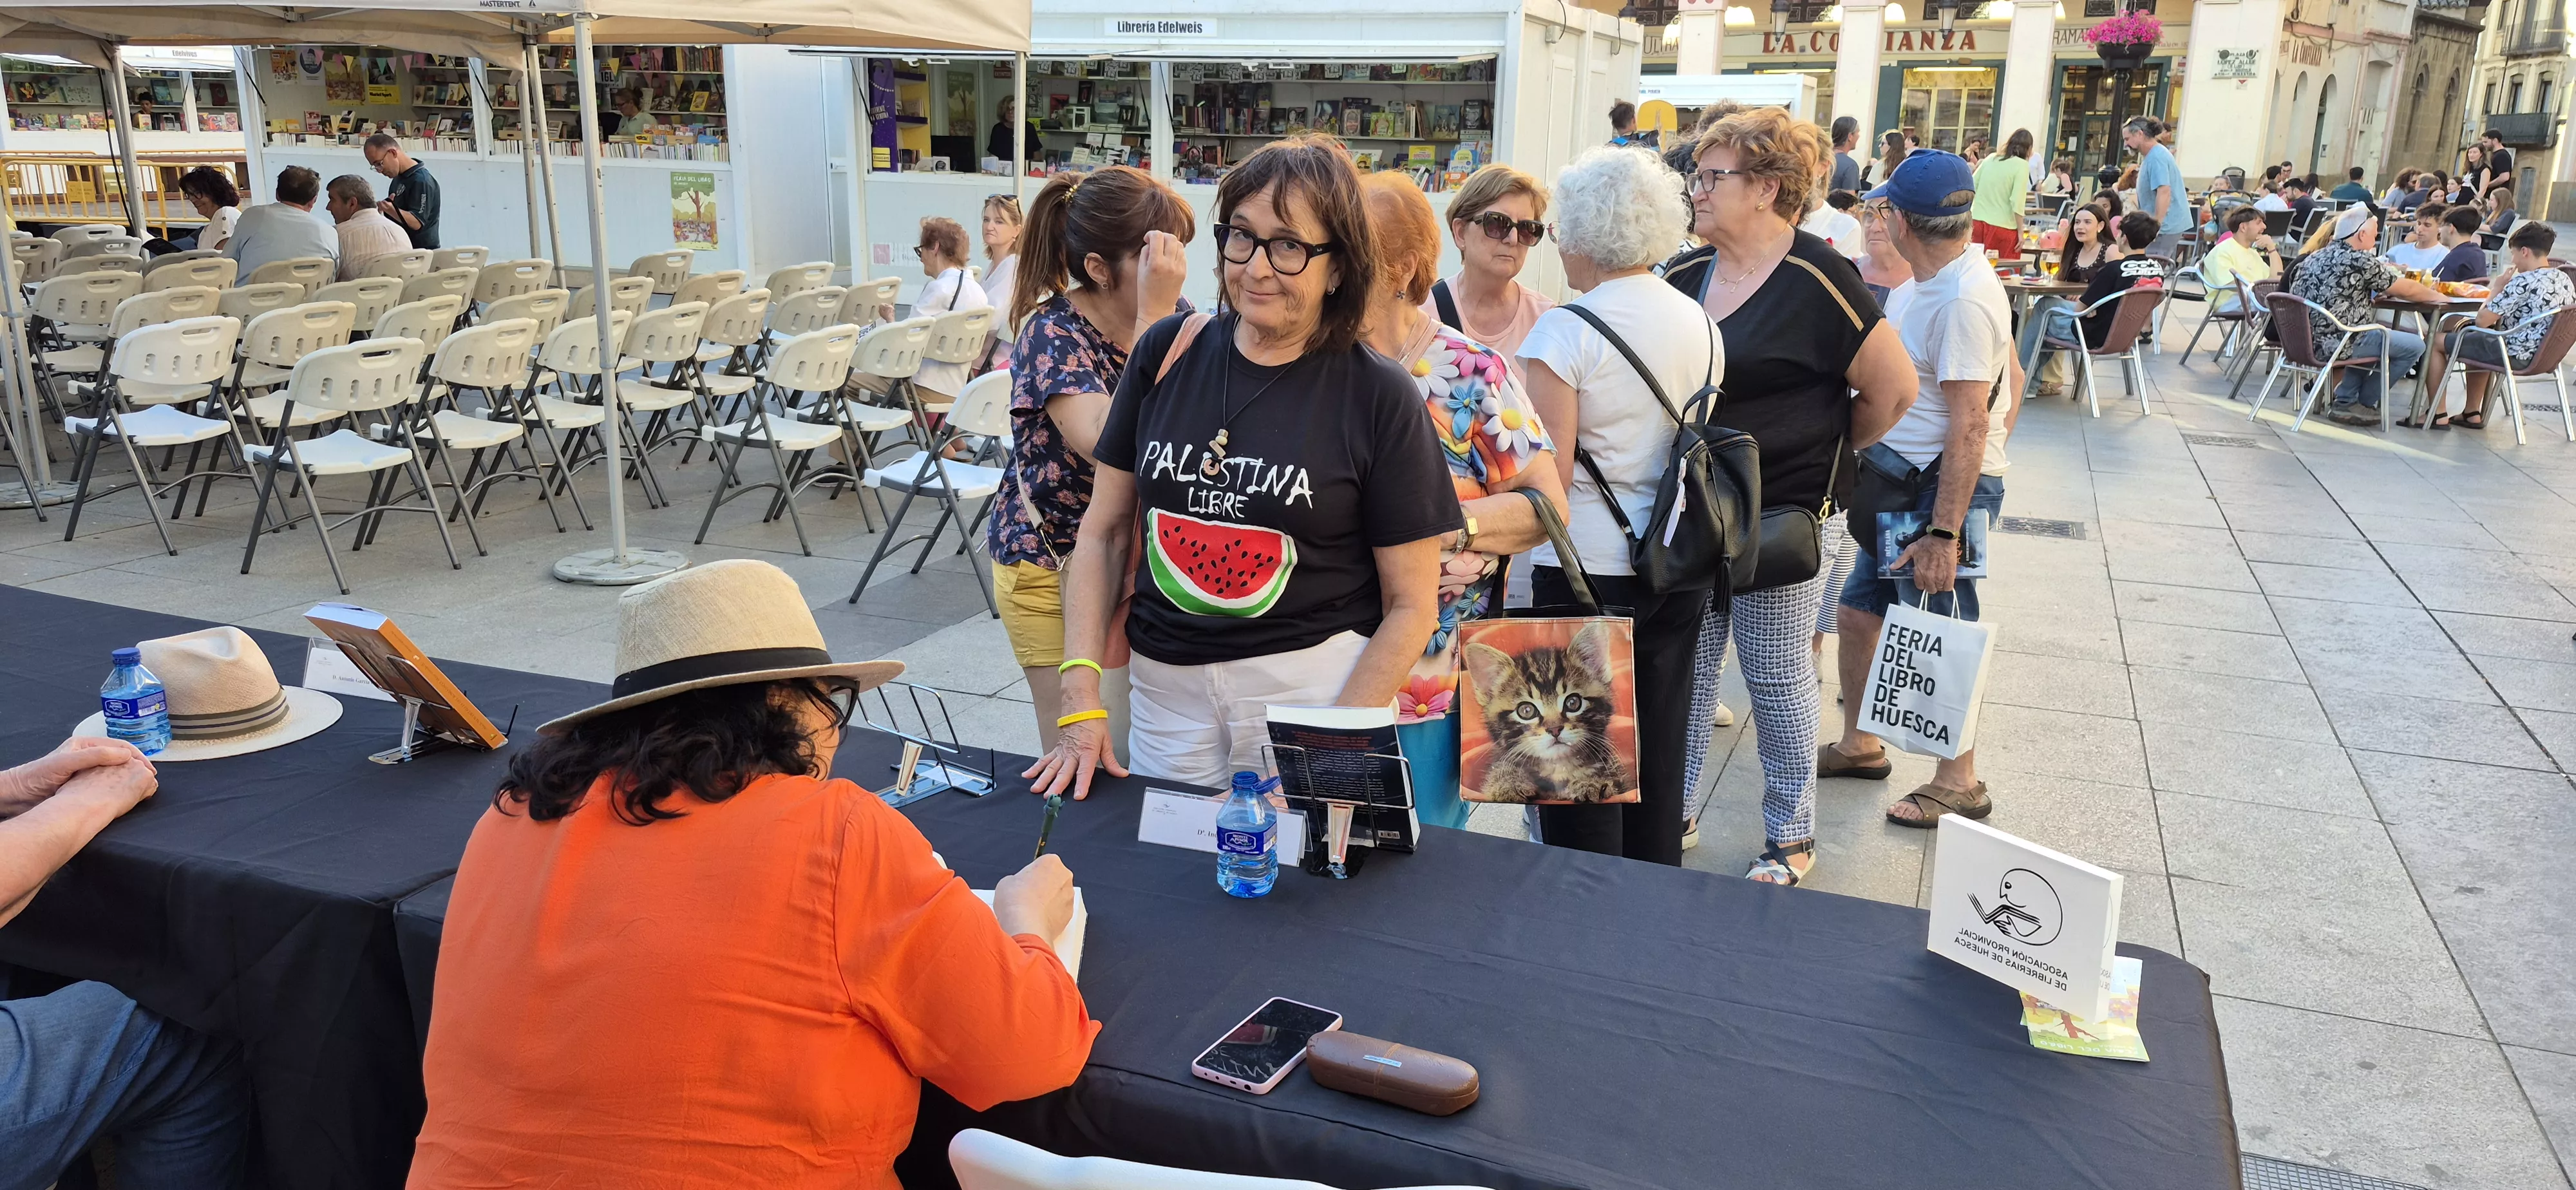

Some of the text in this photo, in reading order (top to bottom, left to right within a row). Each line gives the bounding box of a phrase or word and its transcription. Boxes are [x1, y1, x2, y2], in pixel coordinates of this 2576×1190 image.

[1117, 21, 1203, 33] Librería Edelweis
[1763, 31, 1975, 53] LA COIANZA
[1140, 440, 1314, 509] PALESTINA
[1188, 486, 1249, 519] LIBRE
[1882, 643, 1917, 670] DEL
[1886, 623, 1942, 657] FERIA
[1874, 683, 1900, 707] DE
[1878, 663, 1936, 697] LIBRO
[1870, 703, 1949, 746] HUESCA
